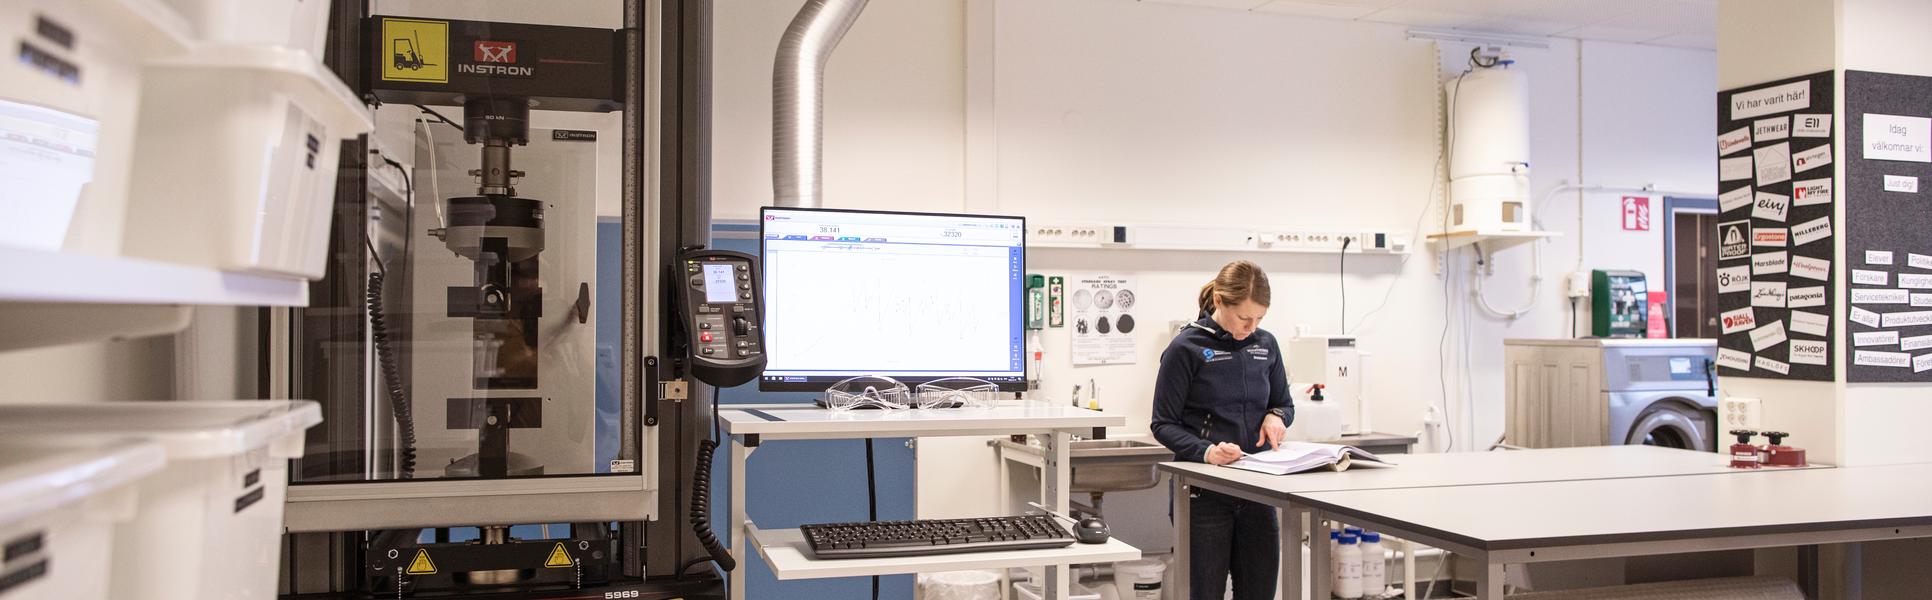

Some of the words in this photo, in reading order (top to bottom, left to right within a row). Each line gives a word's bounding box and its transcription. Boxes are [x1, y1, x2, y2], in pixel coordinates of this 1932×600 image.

[458, 63, 532, 76] INSTRON
[1735, 101, 1745, 110] Vi
[1747, 99, 1761, 108] har
[1764, 94, 1784, 105] varit
[1786, 89, 1805, 101] här!
[1755, 123, 1788, 135] JETHWEAR
[1889, 123, 1907, 136] Idag
[1871, 141, 1913, 152] välkomnar
[1794, 223, 1829, 237] HILLEBERG
[1789, 292, 1823, 301] patagonia
[1338, 366, 1348, 377] M
[604, 590, 639, 600] 5969
